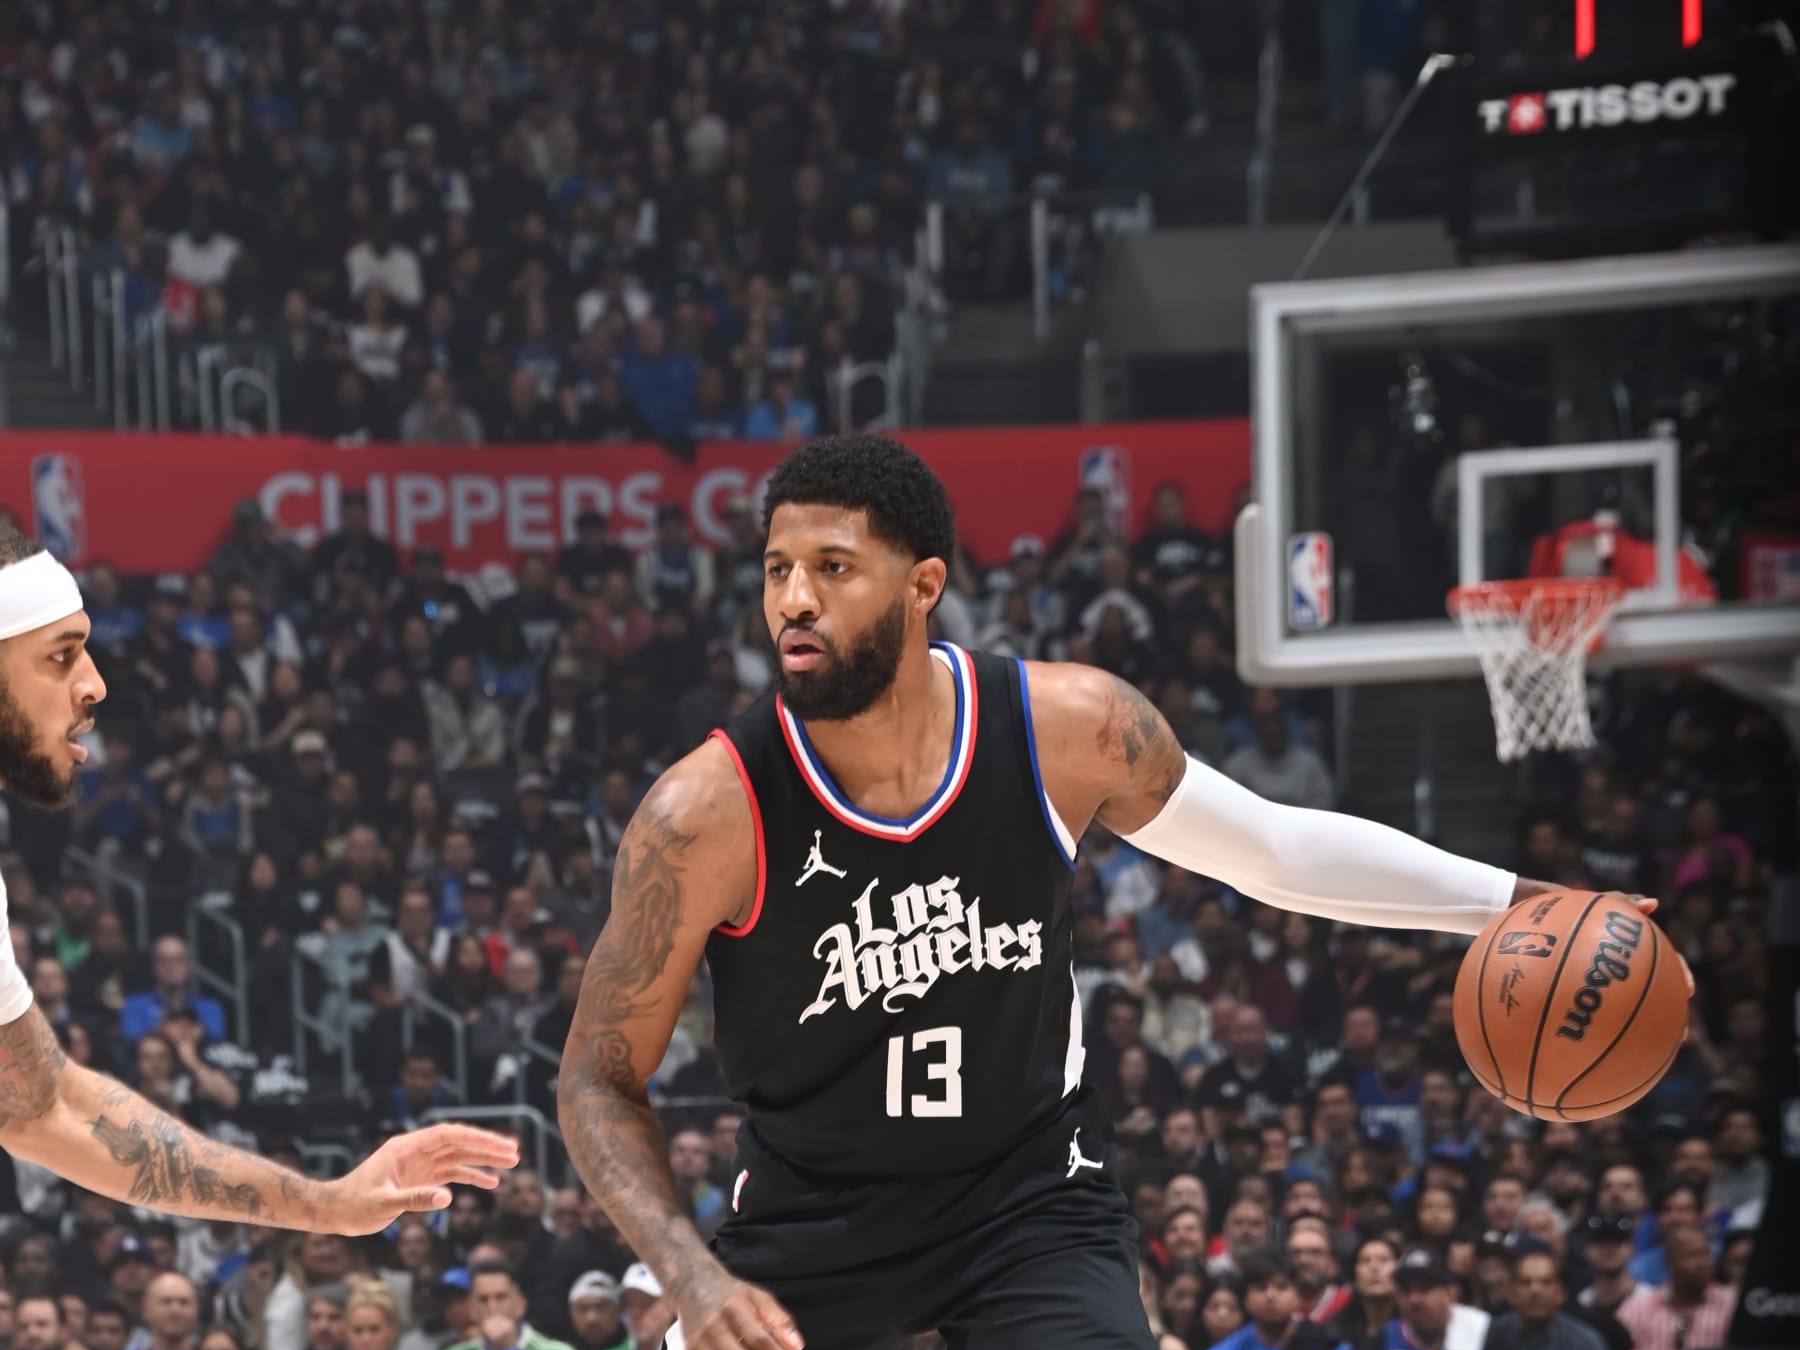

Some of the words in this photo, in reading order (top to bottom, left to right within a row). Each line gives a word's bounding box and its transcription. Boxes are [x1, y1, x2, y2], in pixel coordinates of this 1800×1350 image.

[1548, 74, 1736, 131] TISSOT
[852, 876, 964, 952] Los
[799, 897, 1042, 1024] Angeles
[1555, 910, 1643, 1042] Wilson
[886, 1026, 962, 1117] 13
